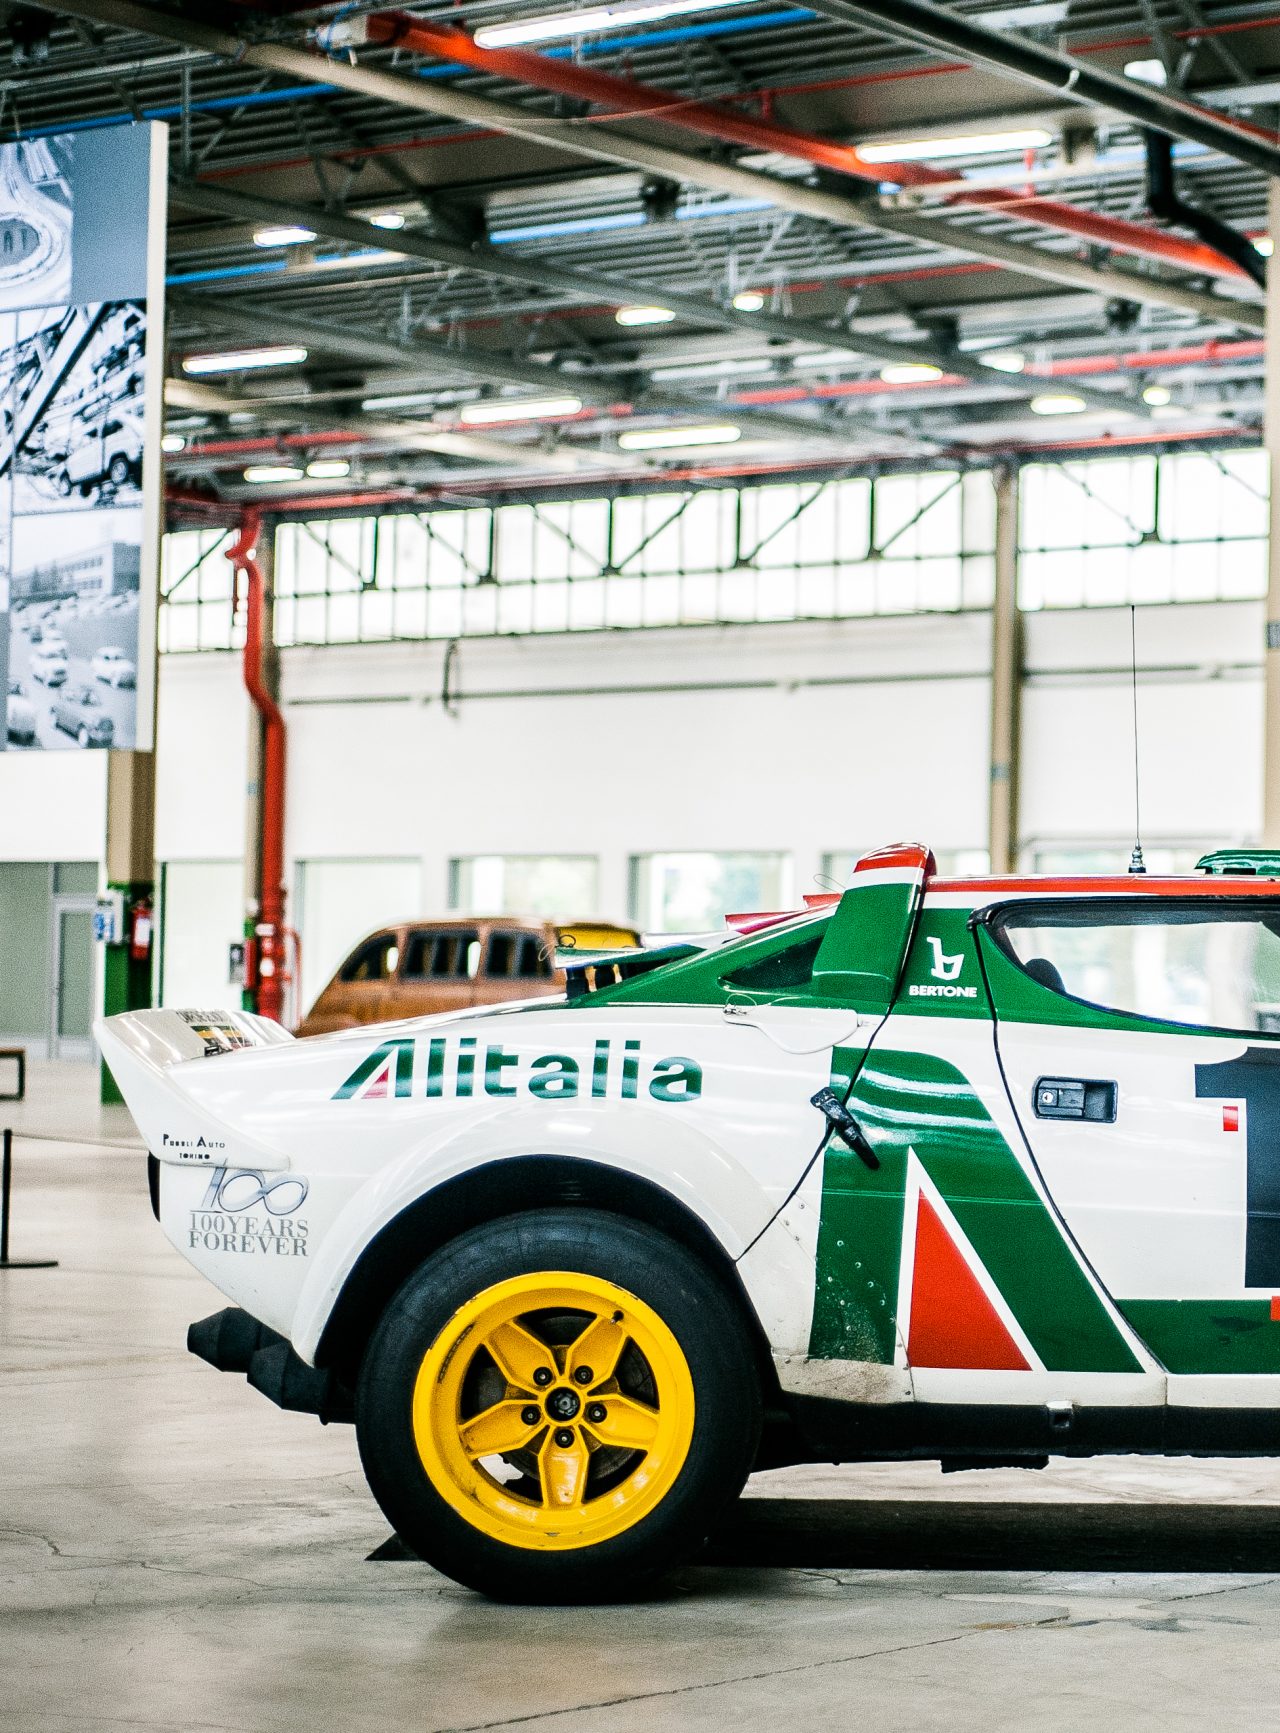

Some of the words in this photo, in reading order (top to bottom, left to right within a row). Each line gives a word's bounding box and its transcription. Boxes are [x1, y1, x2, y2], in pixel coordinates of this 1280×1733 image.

[909, 985, 978, 997] BERTONE
[331, 1037, 703, 1102] Alitalia
[189, 1230, 309, 1257] FOREVER
